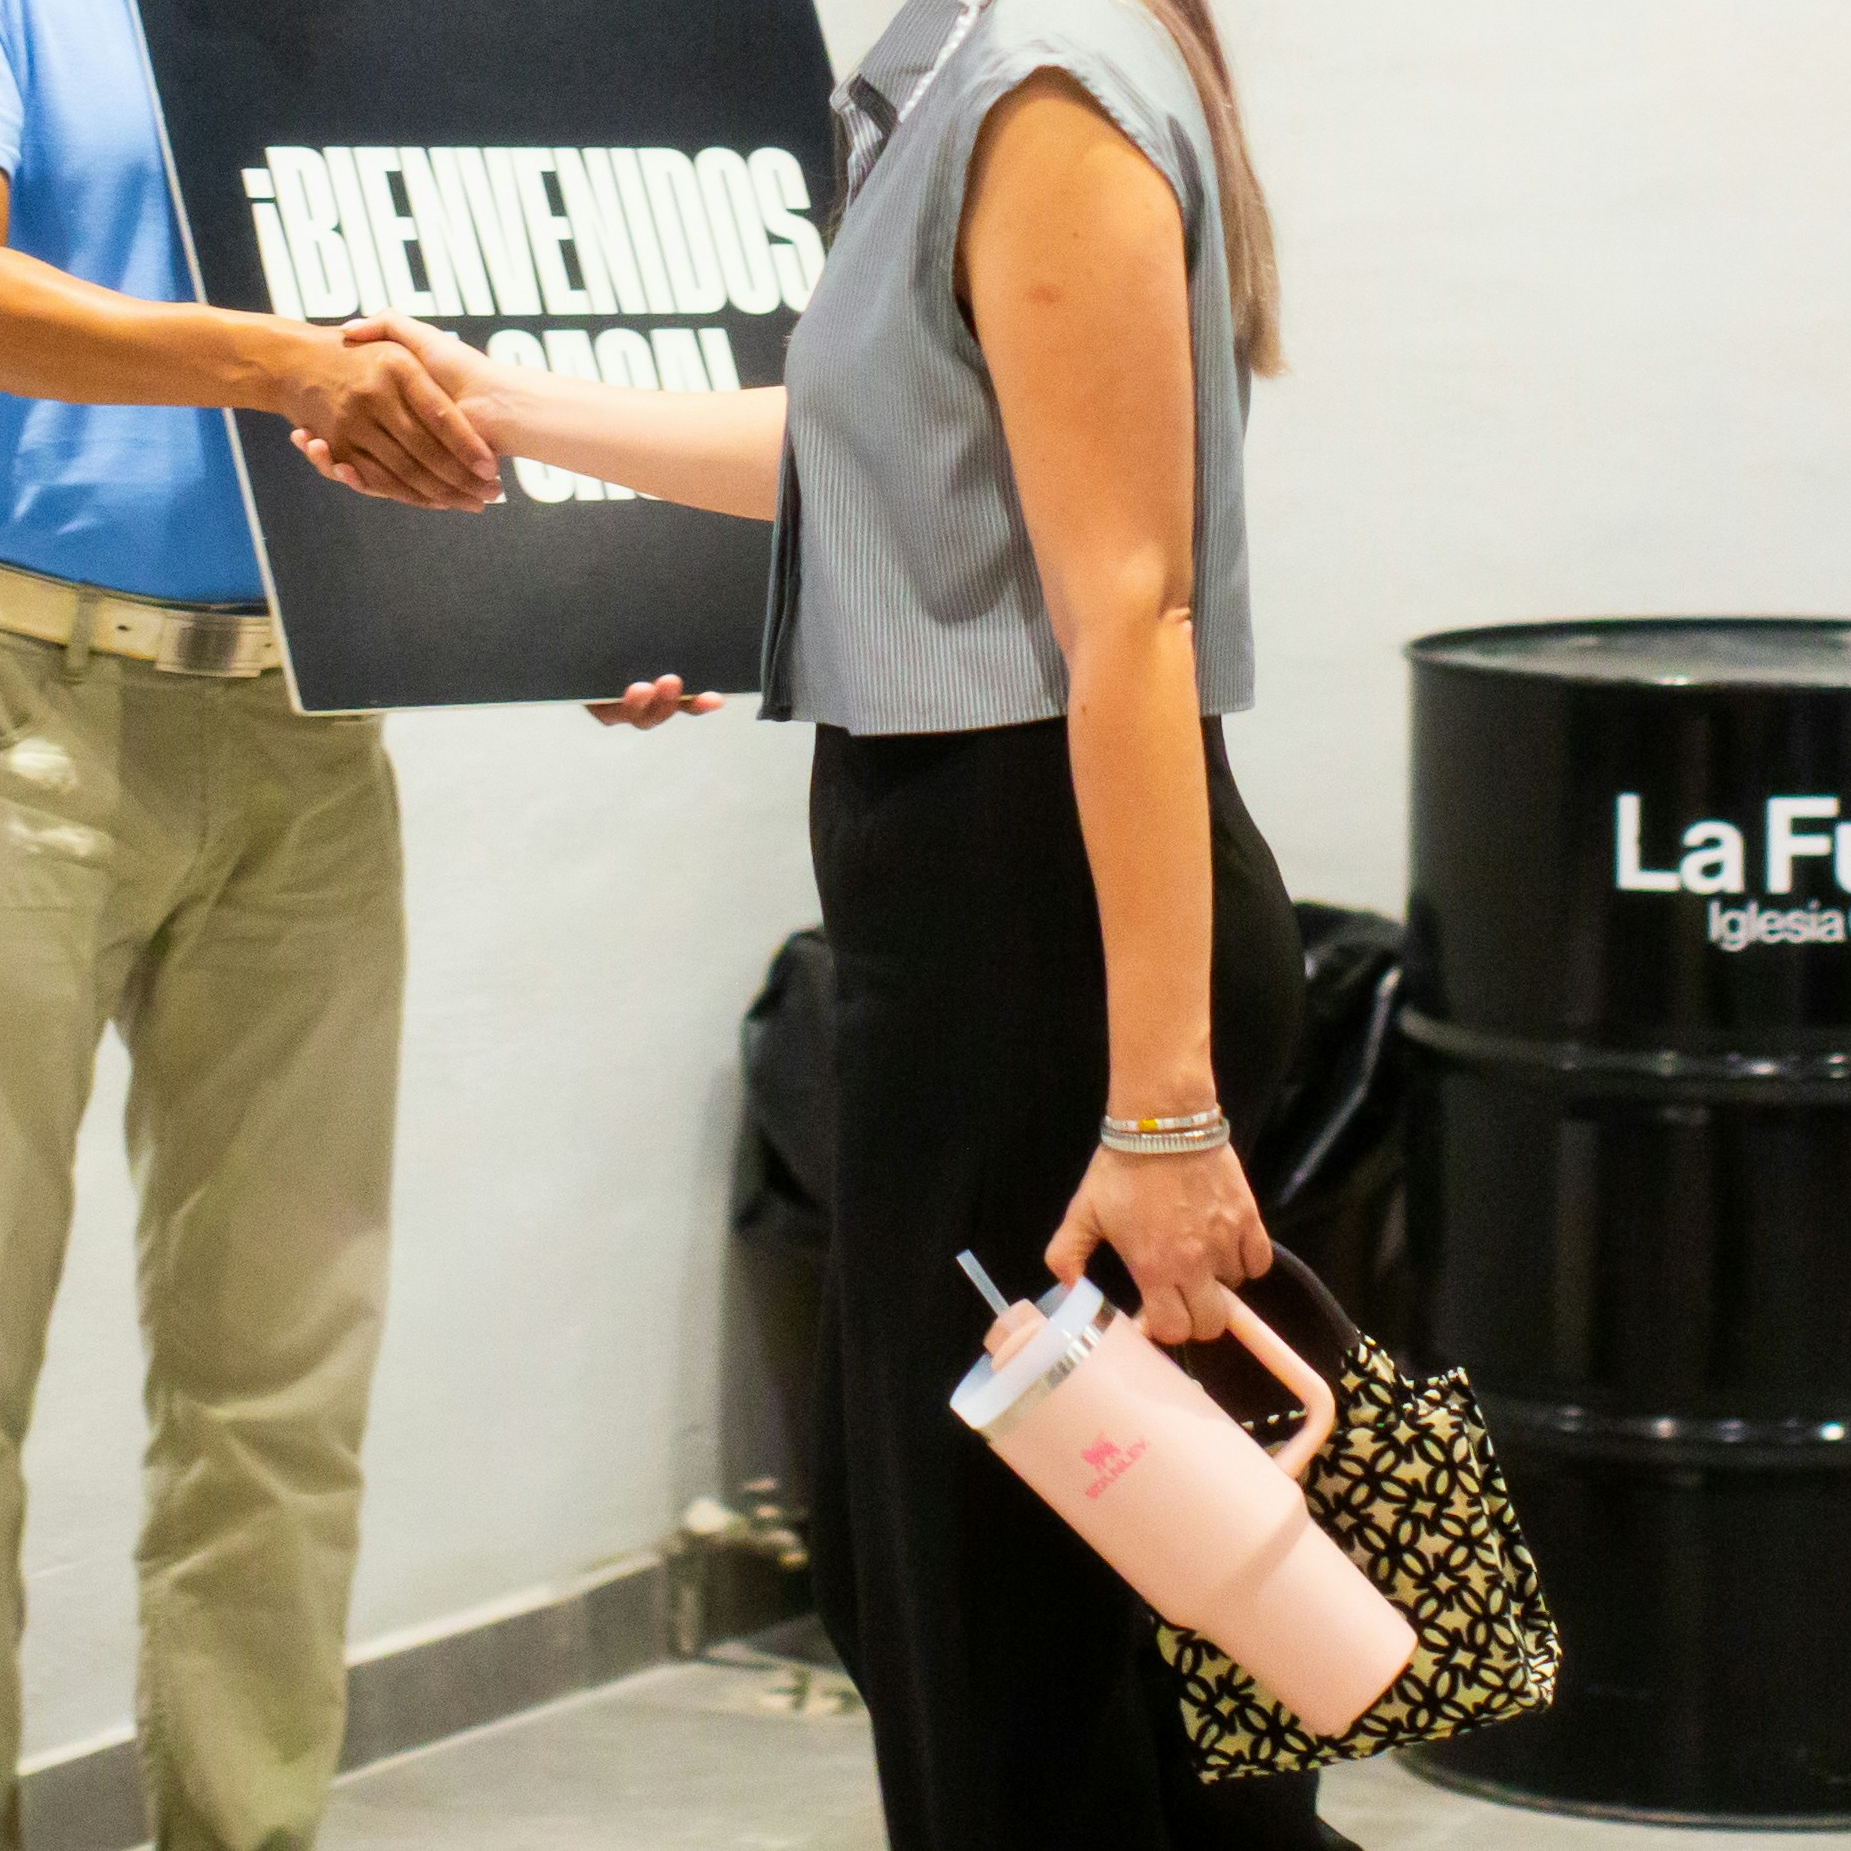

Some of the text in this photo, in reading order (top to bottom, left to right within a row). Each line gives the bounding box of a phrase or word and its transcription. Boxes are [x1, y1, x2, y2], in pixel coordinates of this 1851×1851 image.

[242, 146, 826, 322] ¡BIENVENIDOS
[1616, 792, 1745, 894] La
[1708, 900, 1846, 952] Iglesia
